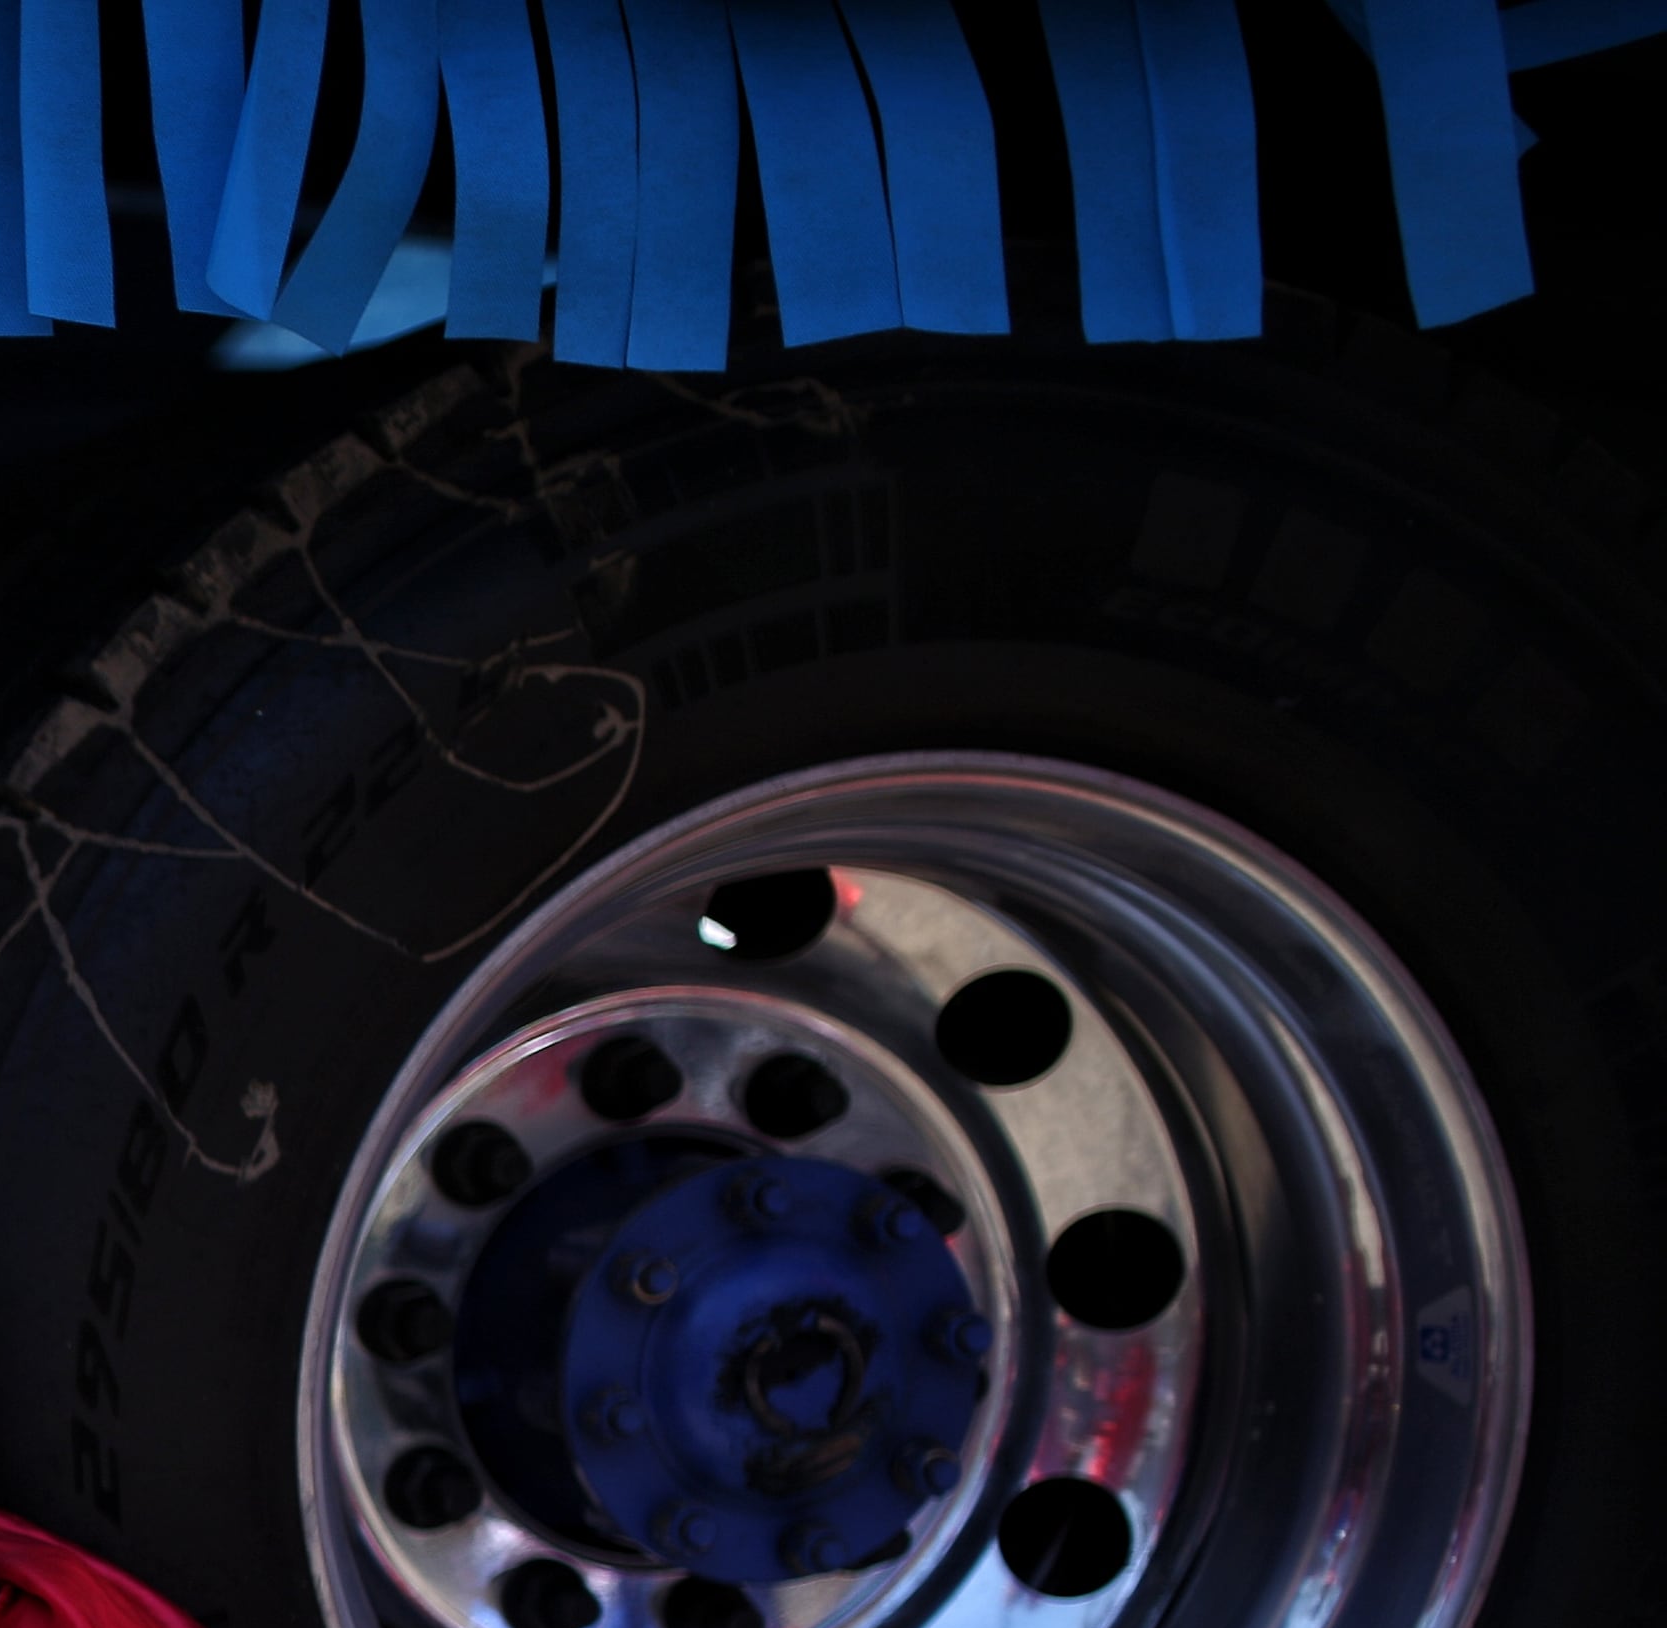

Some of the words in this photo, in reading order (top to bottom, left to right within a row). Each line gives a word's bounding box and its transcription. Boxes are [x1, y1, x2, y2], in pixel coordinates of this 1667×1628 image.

[71, 992, 210, 1530] 295/80
[218, 885, 278, 998] R
[300, 656, 517, 890] 225
